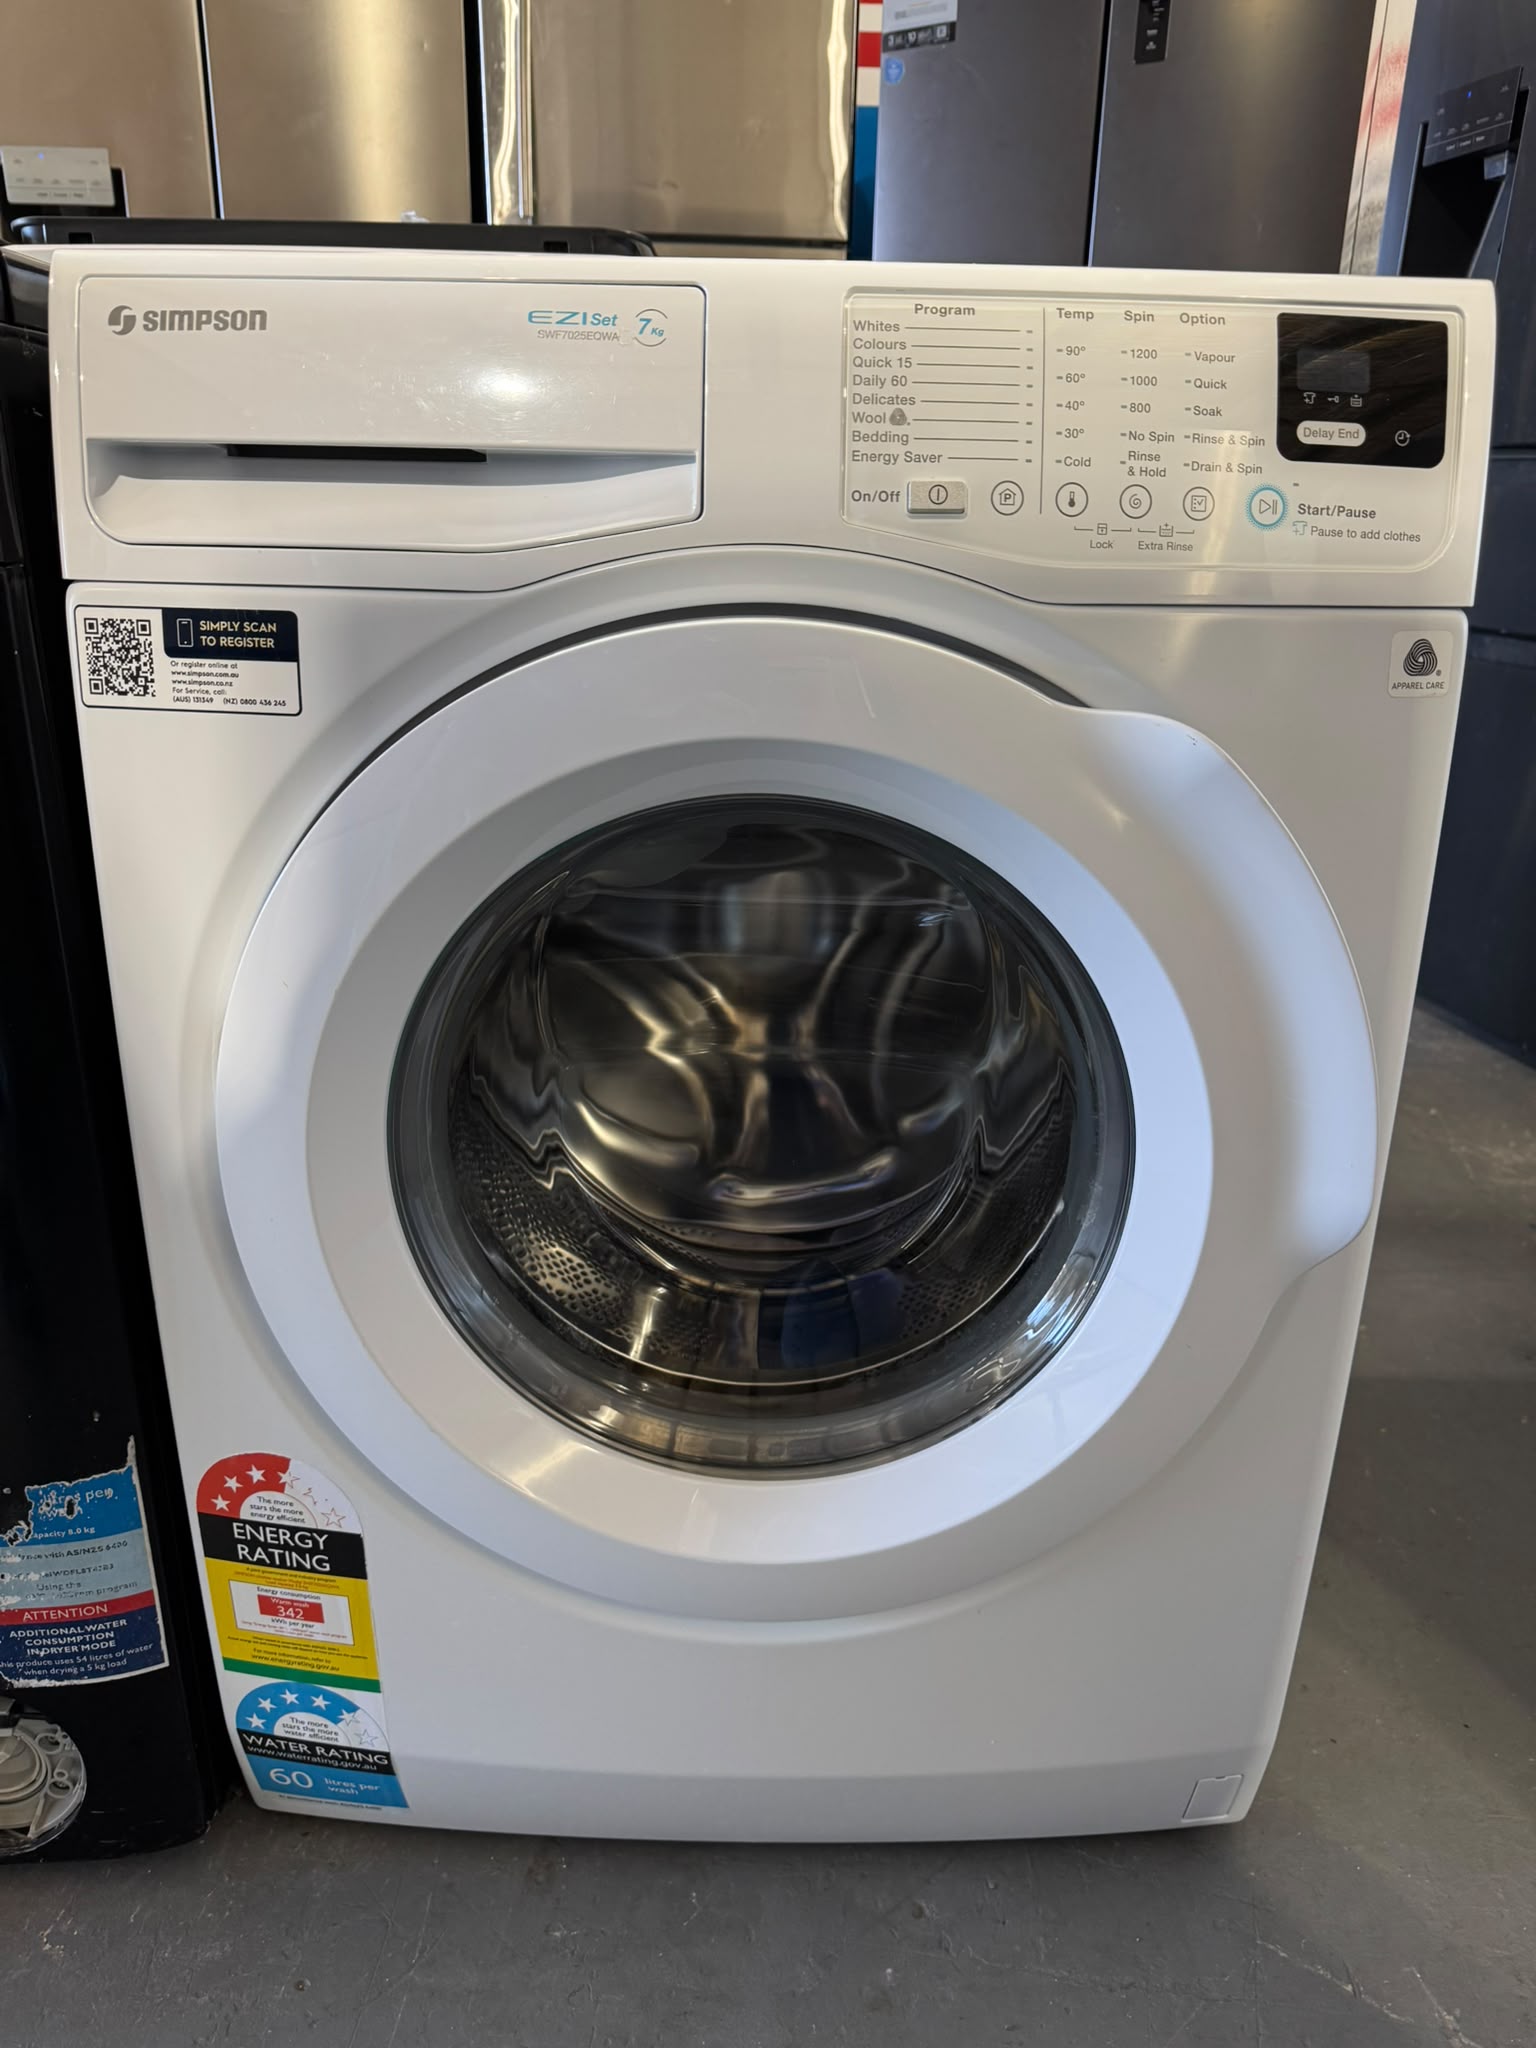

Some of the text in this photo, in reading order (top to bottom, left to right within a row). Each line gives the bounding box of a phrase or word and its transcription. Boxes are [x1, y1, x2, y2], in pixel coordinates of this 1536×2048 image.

[914, 303, 976, 317] Program
[1056, 307, 1226, 326] Temp Spin Option
[143, 309, 267, 332] SIMPSON
[853, 320, 901, 333] Whites
[852, 337, 908, 350] Colours
[1130, 348, 1158, 359] 1200
[1194, 351, 1236, 364] Vapour
[852, 355, 913, 369] Quick 15
[852, 374, 908, 389] Daily 60
[1130, 375, 1158, 387] 1000
[1193, 377, 1227, 390] Quick
[852, 392, 917, 406] Delicates
[1129, 402, 1151, 413] 800
[1193, 405, 1223, 417] Soak
[852, 411, 887, 424] Wool
[852, 430, 910, 446] Bedding
[1128, 430, 1175, 443] No Spin
[1191, 433, 1266, 447] Rinse & Spin
[1303, 427, 1360, 440] Delay End
[851, 449, 943, 465] Energy Saver
[1064, 456, 1092, 467] Cold
[1128, 450, 1161, 462] Rinse
[1127, 466, 1167, 477] & Hold
[1191, 461, 1263, 475] Drain & Spin
[851, 489, 901, 503] On/Off
[1297, 502, 1377, 519] Start/Pause
[1310, 525, 1422, 542] Pause to add clothes
[1089, 539, 1114, 550] Lock
[1138, 540, 1194, 552] Extra Rinse
[200, 620, 277, 634] SIMPLY SCAN
[200, 635, 275, 649] TO REGISTER
[170, 659, 238, 670] Or register online at
[171, 669, 240, 679] www.simpson.com.au
[172, 678, 234, 688] www.simpson.co.nz
[1391, 681, 1446, 690] APPAREL CARE
[172, 686, 183, 695] For
[173, 696, 192, 704] (AUS)
[223, 697, 239, 706] (NZ)
[257, 1496, 294, 1507] The more
[250, 1504, 268, 1512] stars
[283, 1508, 304, 1516] more
[250, 1511, 275, 1521] energy
[232, 1522, 329, 1550] ENERGY
[237, 1544, 331, 1572] RATING
[257, 1586, 279, 1595] Energy
[23, 1603, 109, 1621] ATTENTION
[277, 1605, 305, 1620] 342
[9, 1618, 128, 1639] ADDITIONAL WATER
[25, 1631, 115, 1647] CONSUMPTION
[40, 1643, 78, 1656] DRYER
[81, 1640, 116, 1651] MODE
[54, 1657, 74, 1666] uses
[76, 1655, 88, 1664] 54
[89, 1652, 114, 1663] litres
[114, 1649, 125, 1657] of
[126, 1643, 154, 1656] water
[24, 1667, 48, 1676] when
[49, 1664, 79, 1675] drying
[94, 1662, 107, 1672] kg
[107, 1659, 128, 1669] load
[289, 1716, 329, 1729] The more
[282, 1723, 301, 1731] stars
[317, 1728, 340, 1737] more
[284, 1729, 307, 1738] water
[243, 1733, 389, 1765] WATER RATING
[248, 1745, 378, 1771] www.waterrating.gov.au
[269, 1767, 314, 1789] 60
[324, 1777, 381, 1792] litres per
[327, 1785, 359, 1796] wash
